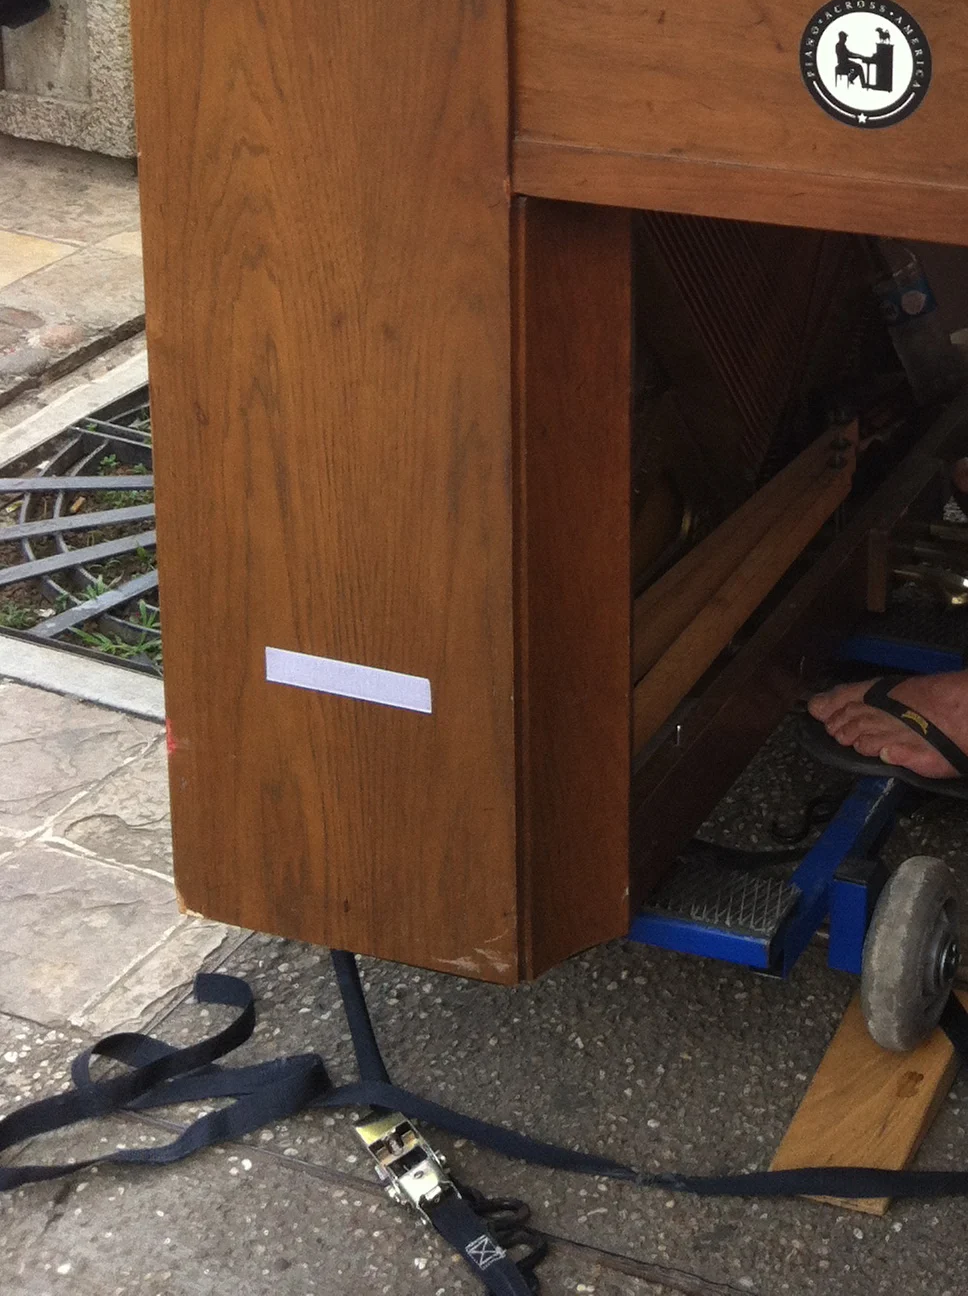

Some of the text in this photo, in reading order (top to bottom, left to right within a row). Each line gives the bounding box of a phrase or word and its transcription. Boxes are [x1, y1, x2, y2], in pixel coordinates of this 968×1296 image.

[804, 0, 925, 88] PIANO ACROSS AMERICA
